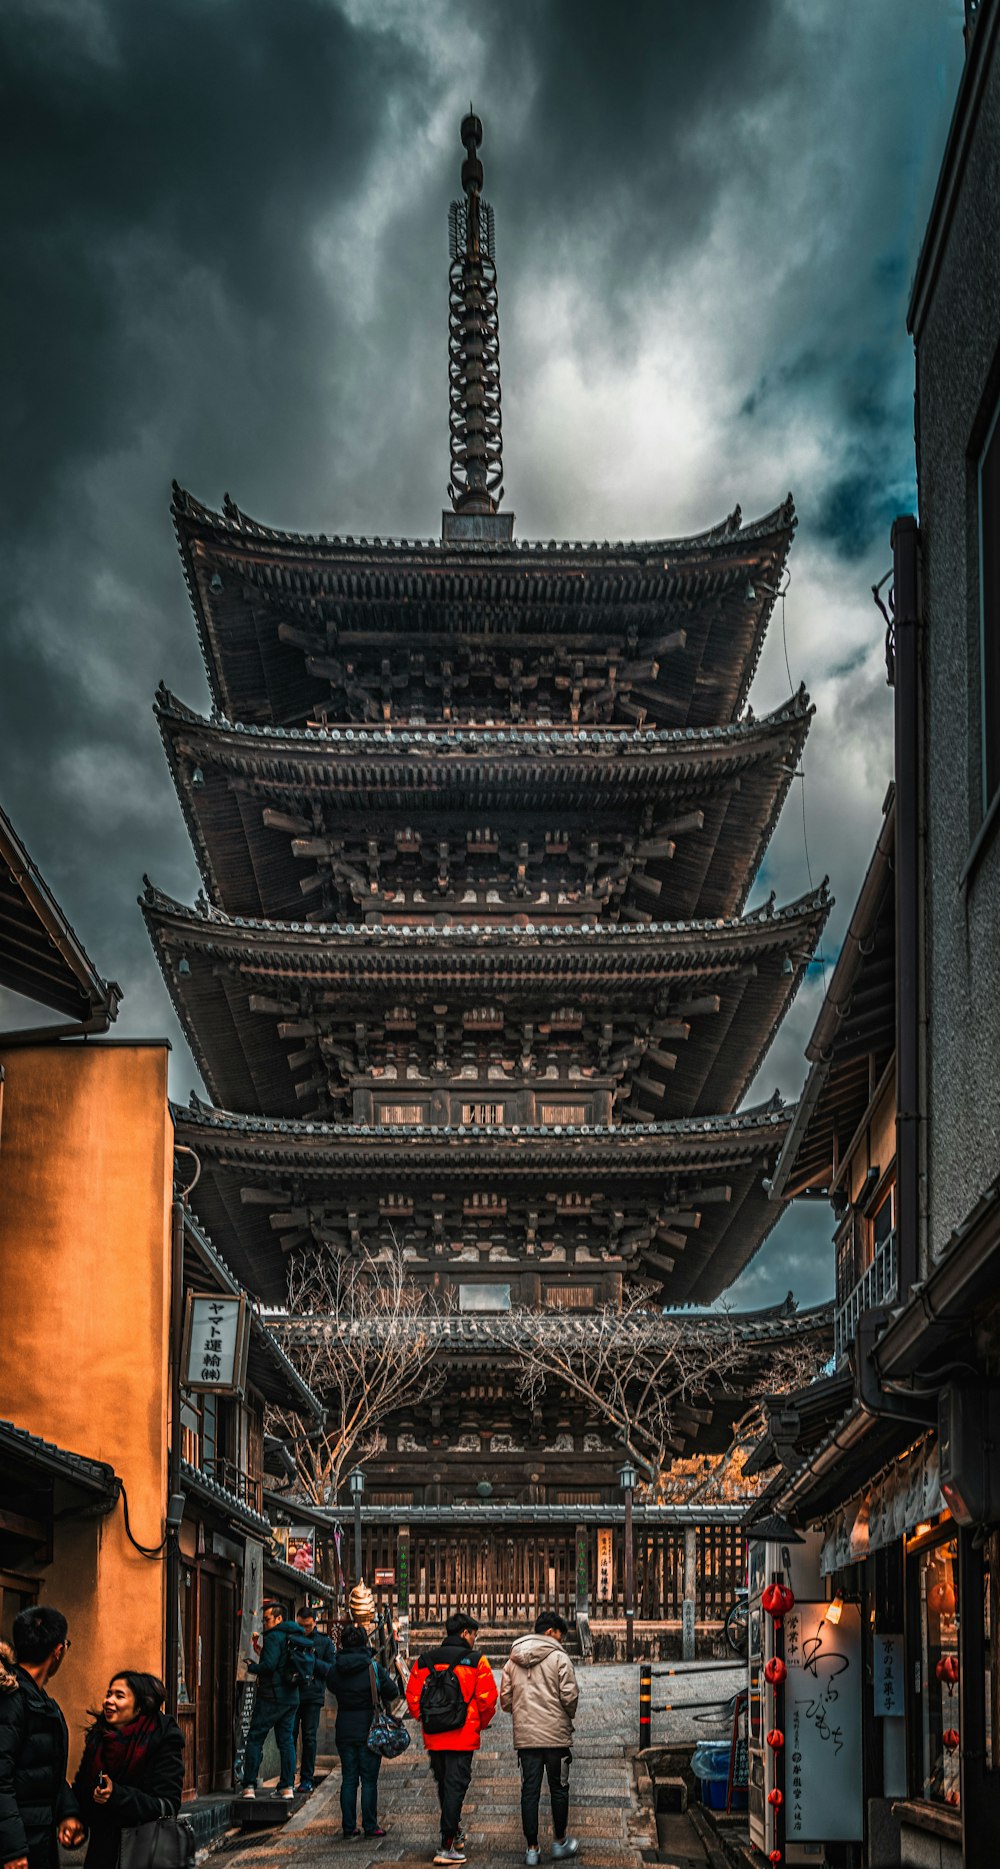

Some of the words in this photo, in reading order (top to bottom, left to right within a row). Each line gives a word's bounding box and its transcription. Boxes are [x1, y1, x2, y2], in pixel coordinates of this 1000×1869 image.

[882, 1640, 895, 1711] 京の豆菓子
